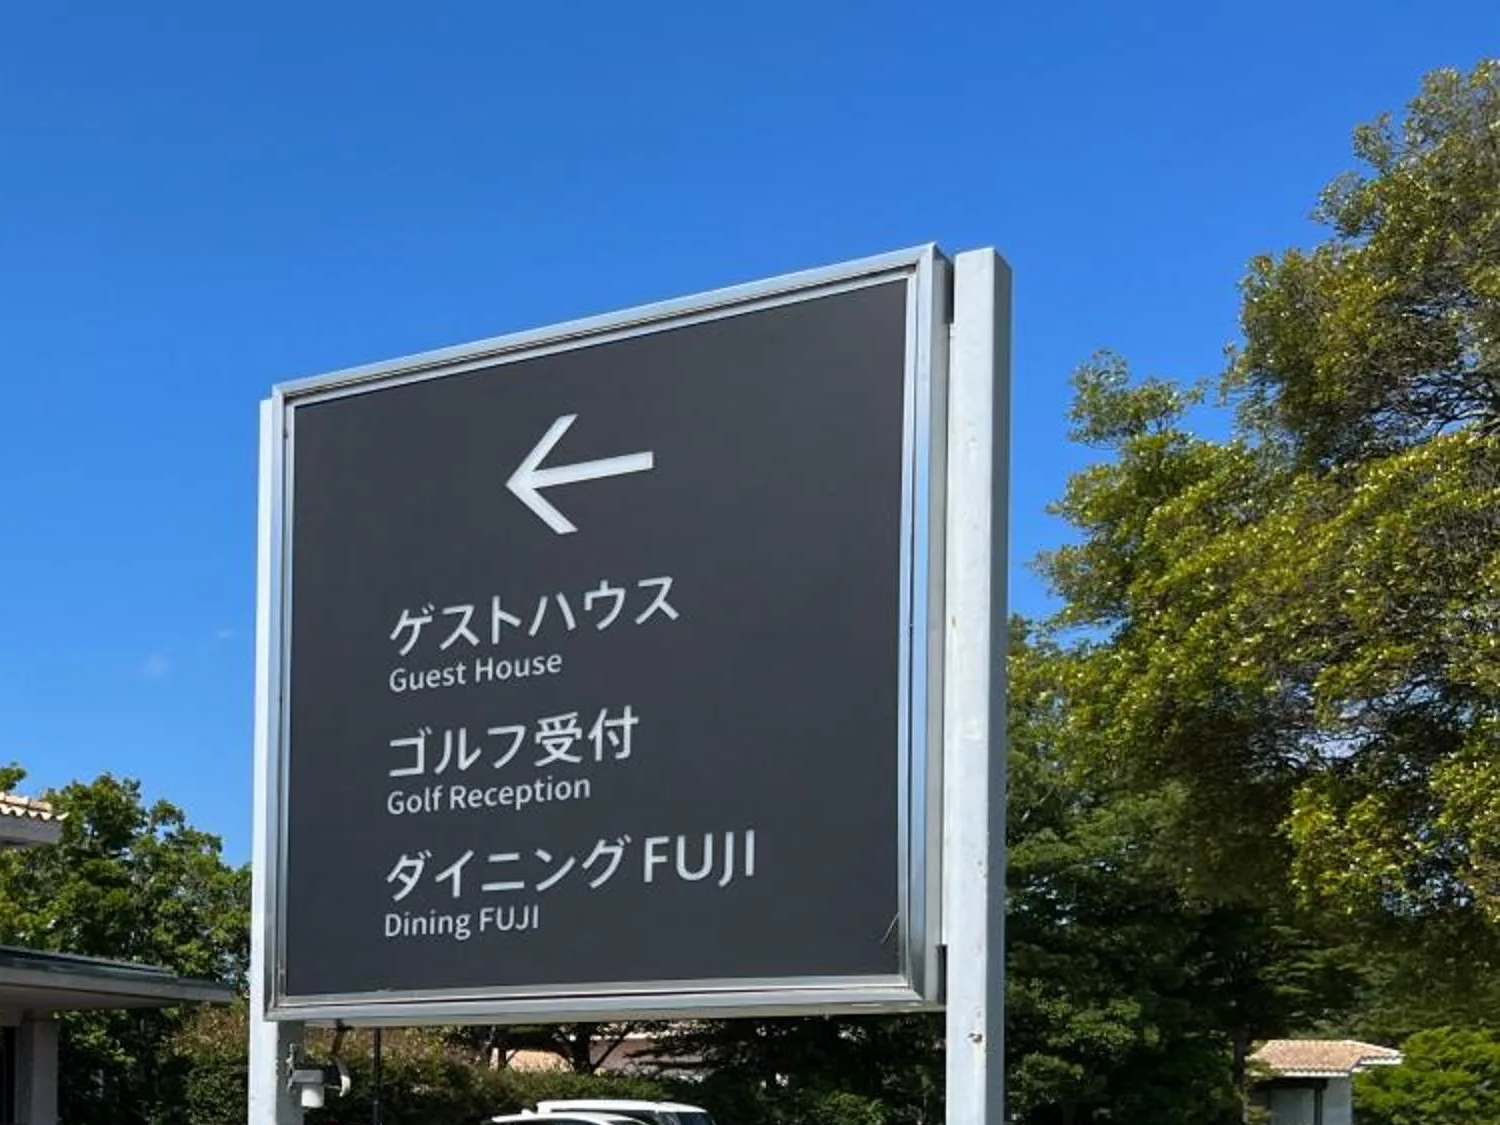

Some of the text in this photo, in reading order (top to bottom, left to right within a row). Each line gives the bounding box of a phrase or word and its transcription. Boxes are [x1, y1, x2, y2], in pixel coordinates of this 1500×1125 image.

[389, 575, 680, 657] ゲストハウス
[389, 654, 563, 693] Guest House
[389, 705, 640, 777] ゴルフ受付
[387, 777, 591, 815] Golf Reception
[385, 905, 539, 941] Dining FUJI
